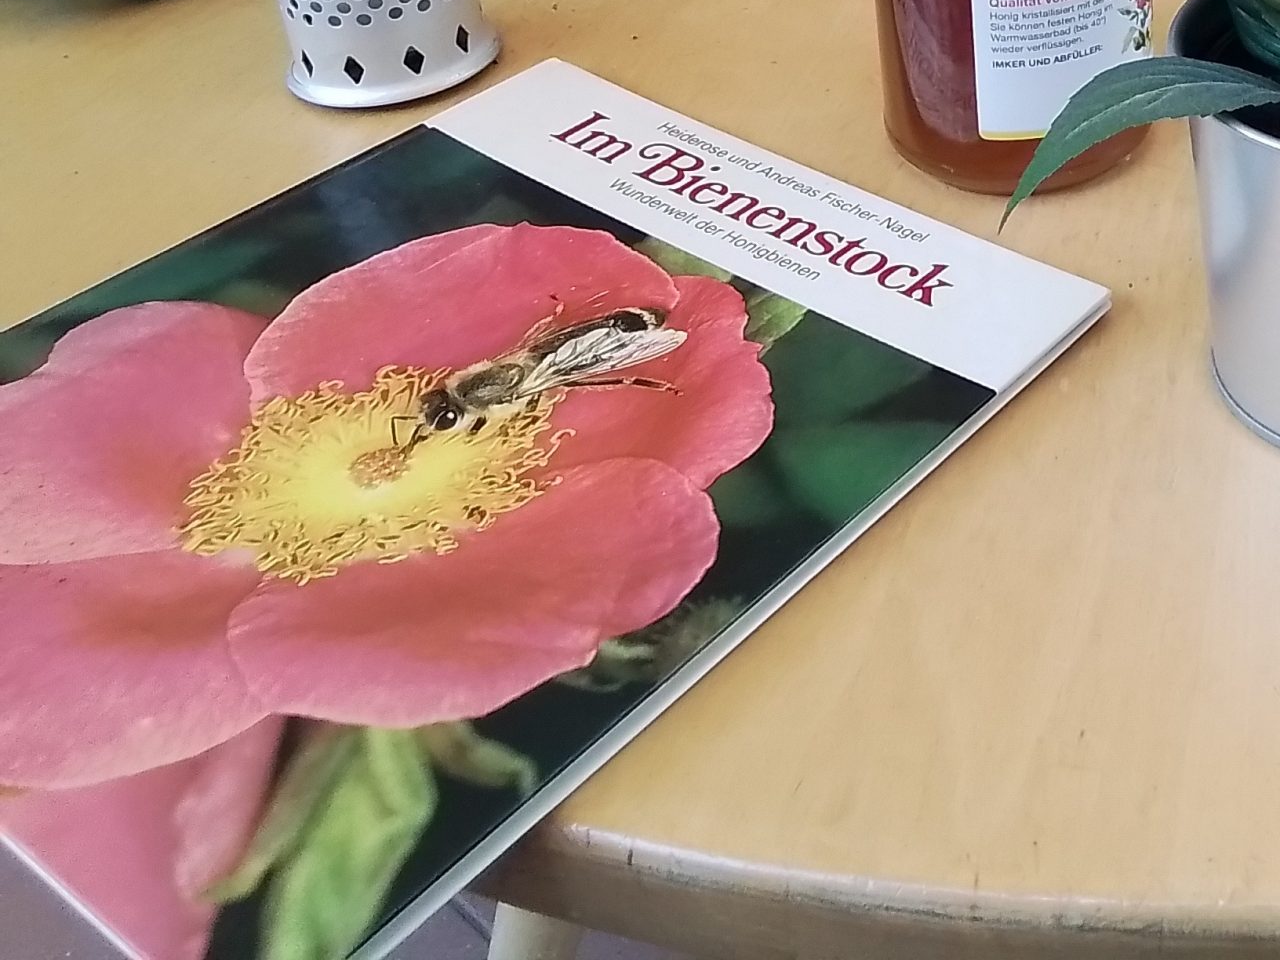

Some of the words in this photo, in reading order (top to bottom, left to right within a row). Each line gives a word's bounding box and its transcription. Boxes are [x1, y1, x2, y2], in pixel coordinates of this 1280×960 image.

[989, 11, 1018, 22] Honig
[1022, 4, 1074, 20] kristallisiert
[1077, 1, 1090, 13] mit
[990, 22, 1006, 32] Sie
[1008, 20, 1045, 31] können
[1047, 16, 1075, 27] festen
[1078, 8, 1103, 22] Honig
[990, 27, 1071, 42] Warmwasserbad
[1073, 24, 1089, 35] (bis
[991, 44, 1024, 54] wieder
[1027, 36, 1083, 52] verflüssigen.
[992, 60, 1025, 69] IMKER
[1028, 57, 1051, 67] UND
[1053, 44, 1104, 64] ABFÜLLER:
[657, 121, 729, 158] Heiderose
[728, 153, 761, 171] und
[757, 166, 820, 198] Andreas
[819, 192, 932, 244] Fischer-Nagel
[550, 111, 633, 164] Im
[632, 143, 954, 307] Bienenstock
[609, 177, 698, 225] Wunderwelt
[694, 220, 726, 236] der
[721, 230, 821, 281] Honigbienen
